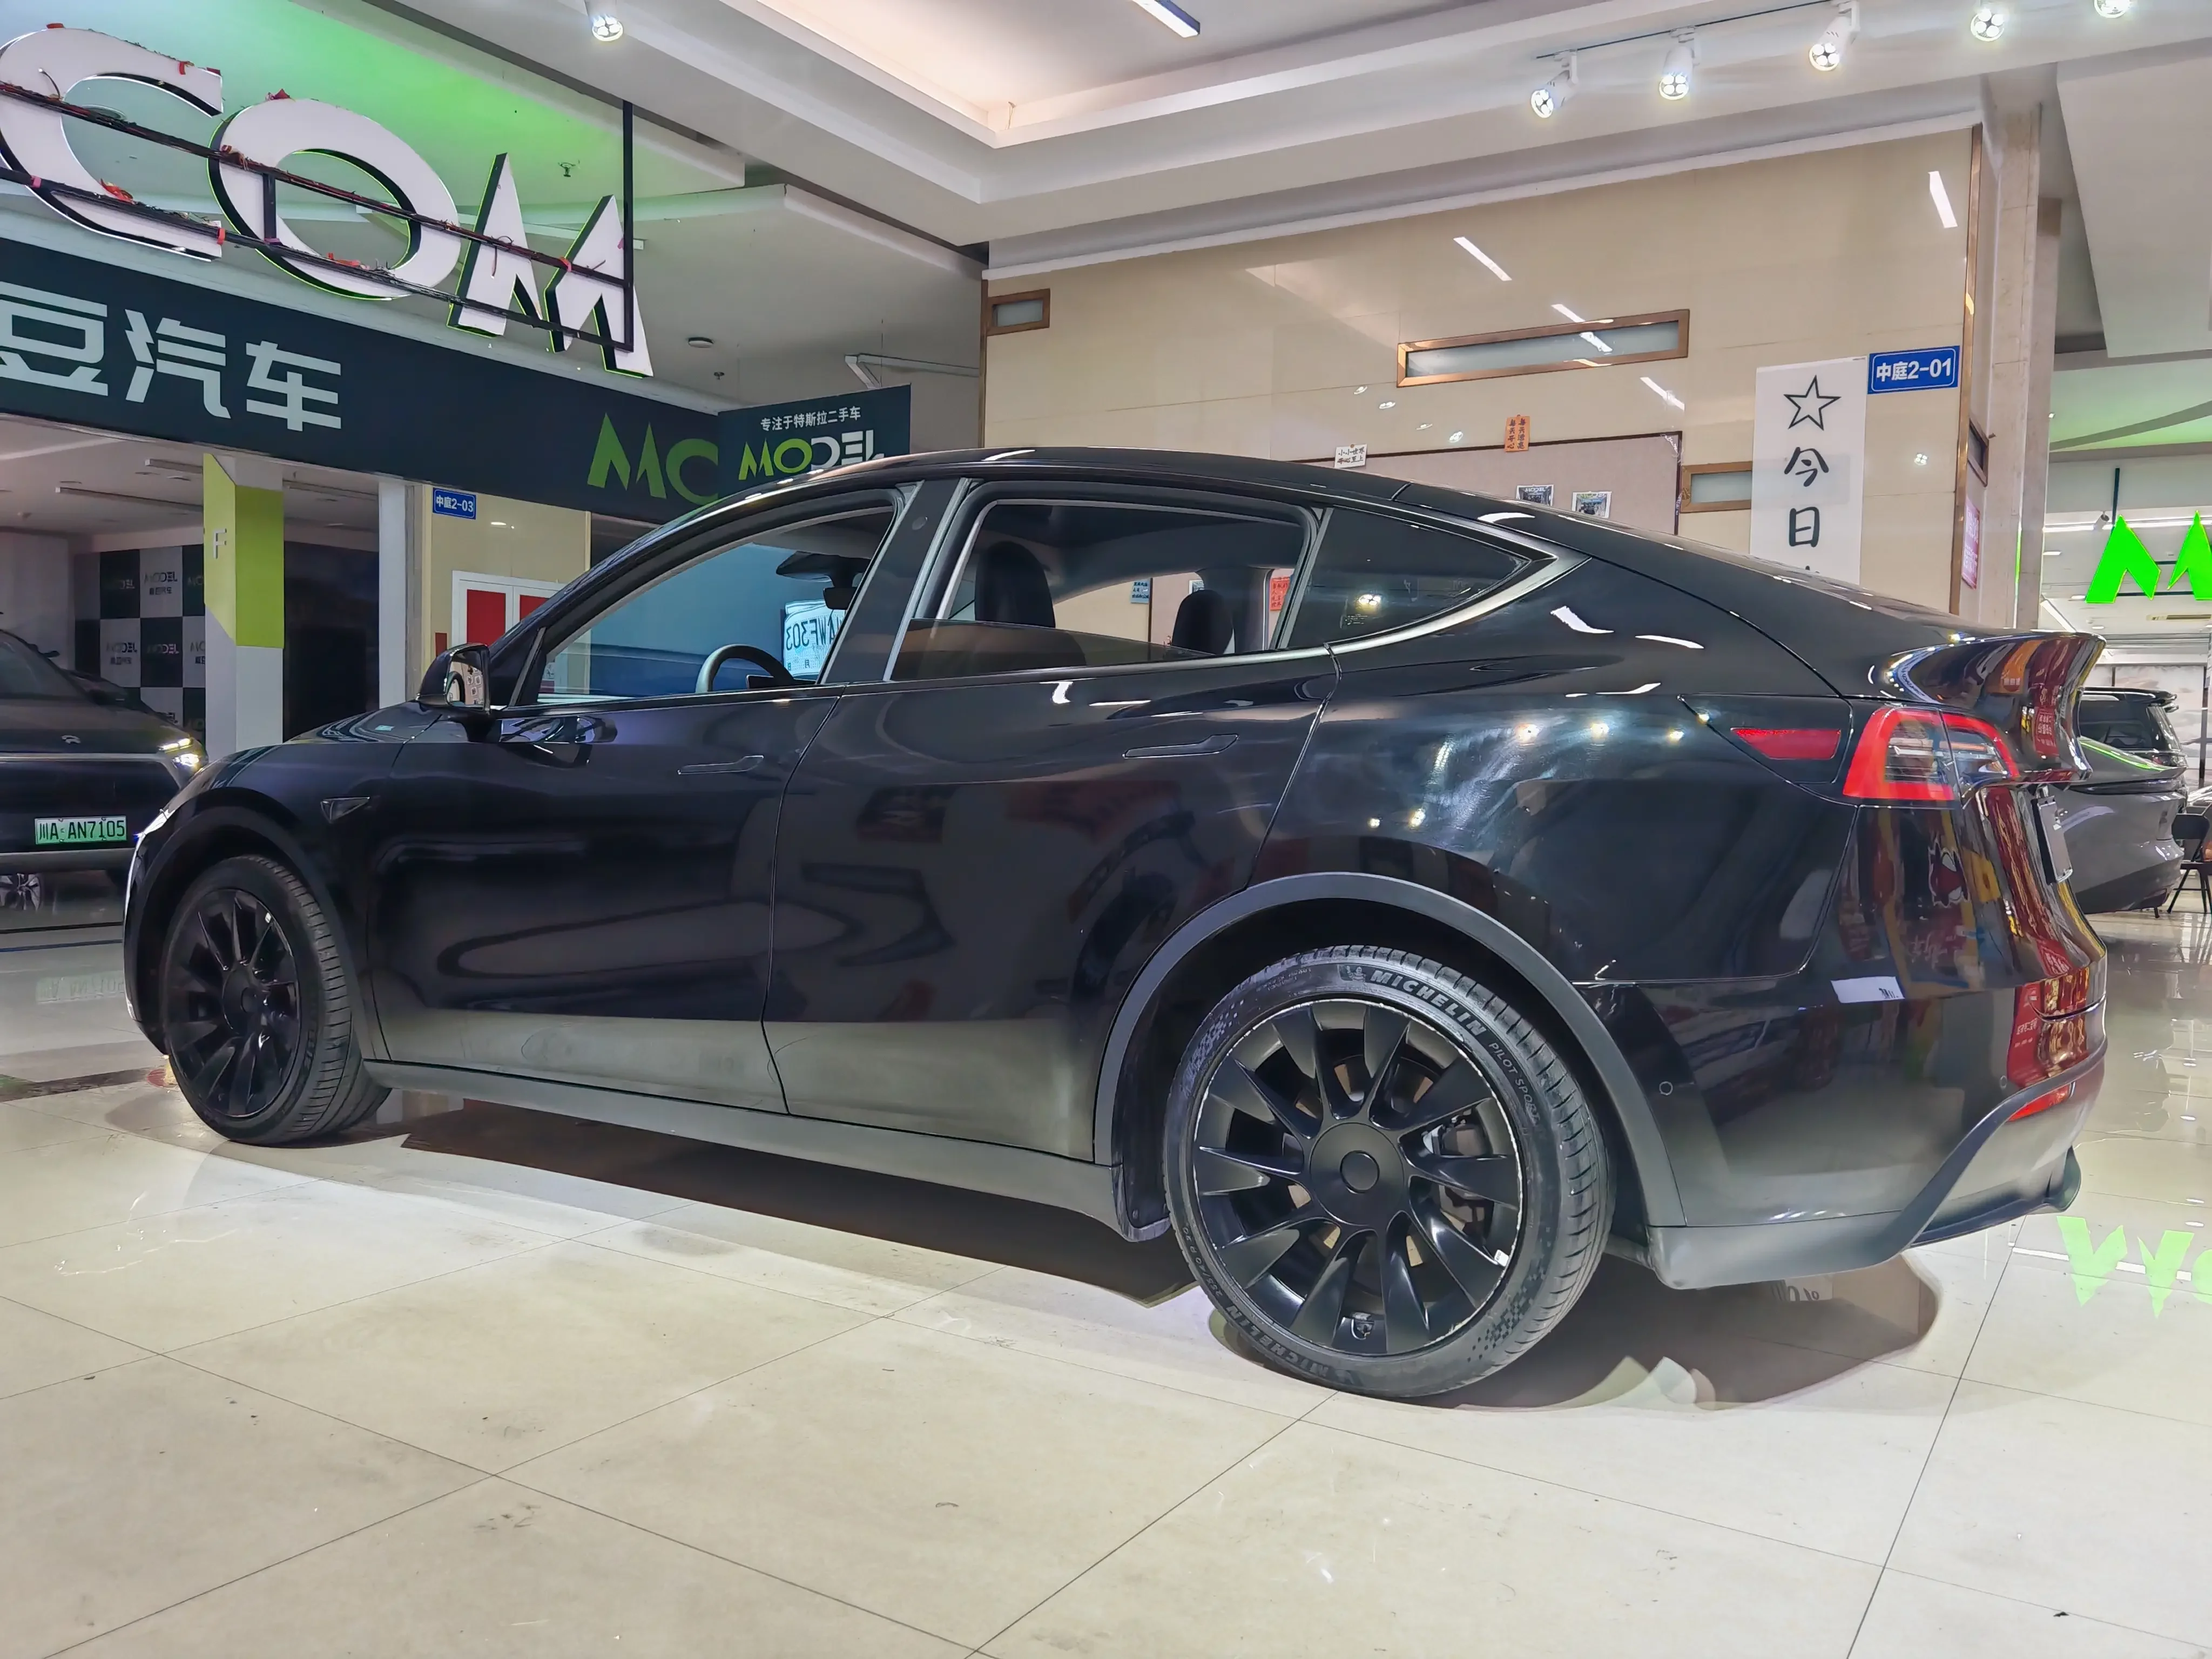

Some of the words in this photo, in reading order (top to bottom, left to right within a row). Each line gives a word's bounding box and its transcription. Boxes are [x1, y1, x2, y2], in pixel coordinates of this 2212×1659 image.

[1876, 358, 1951, 382] 中庭2-01
[760, 406, 861, 431] 专注于特斯拉二手车
[738, 430, 884, 480] MODEL
[436, 495, 474, 512] 中庭2-03
[1784, 447, 1829, 573] 今日
[1370, 969, 1487, 1036] MICHELIN
[1488, 1042, 1518, 1074] PILOT
[1225, 1305, 1328, 1377] MICHELIN
